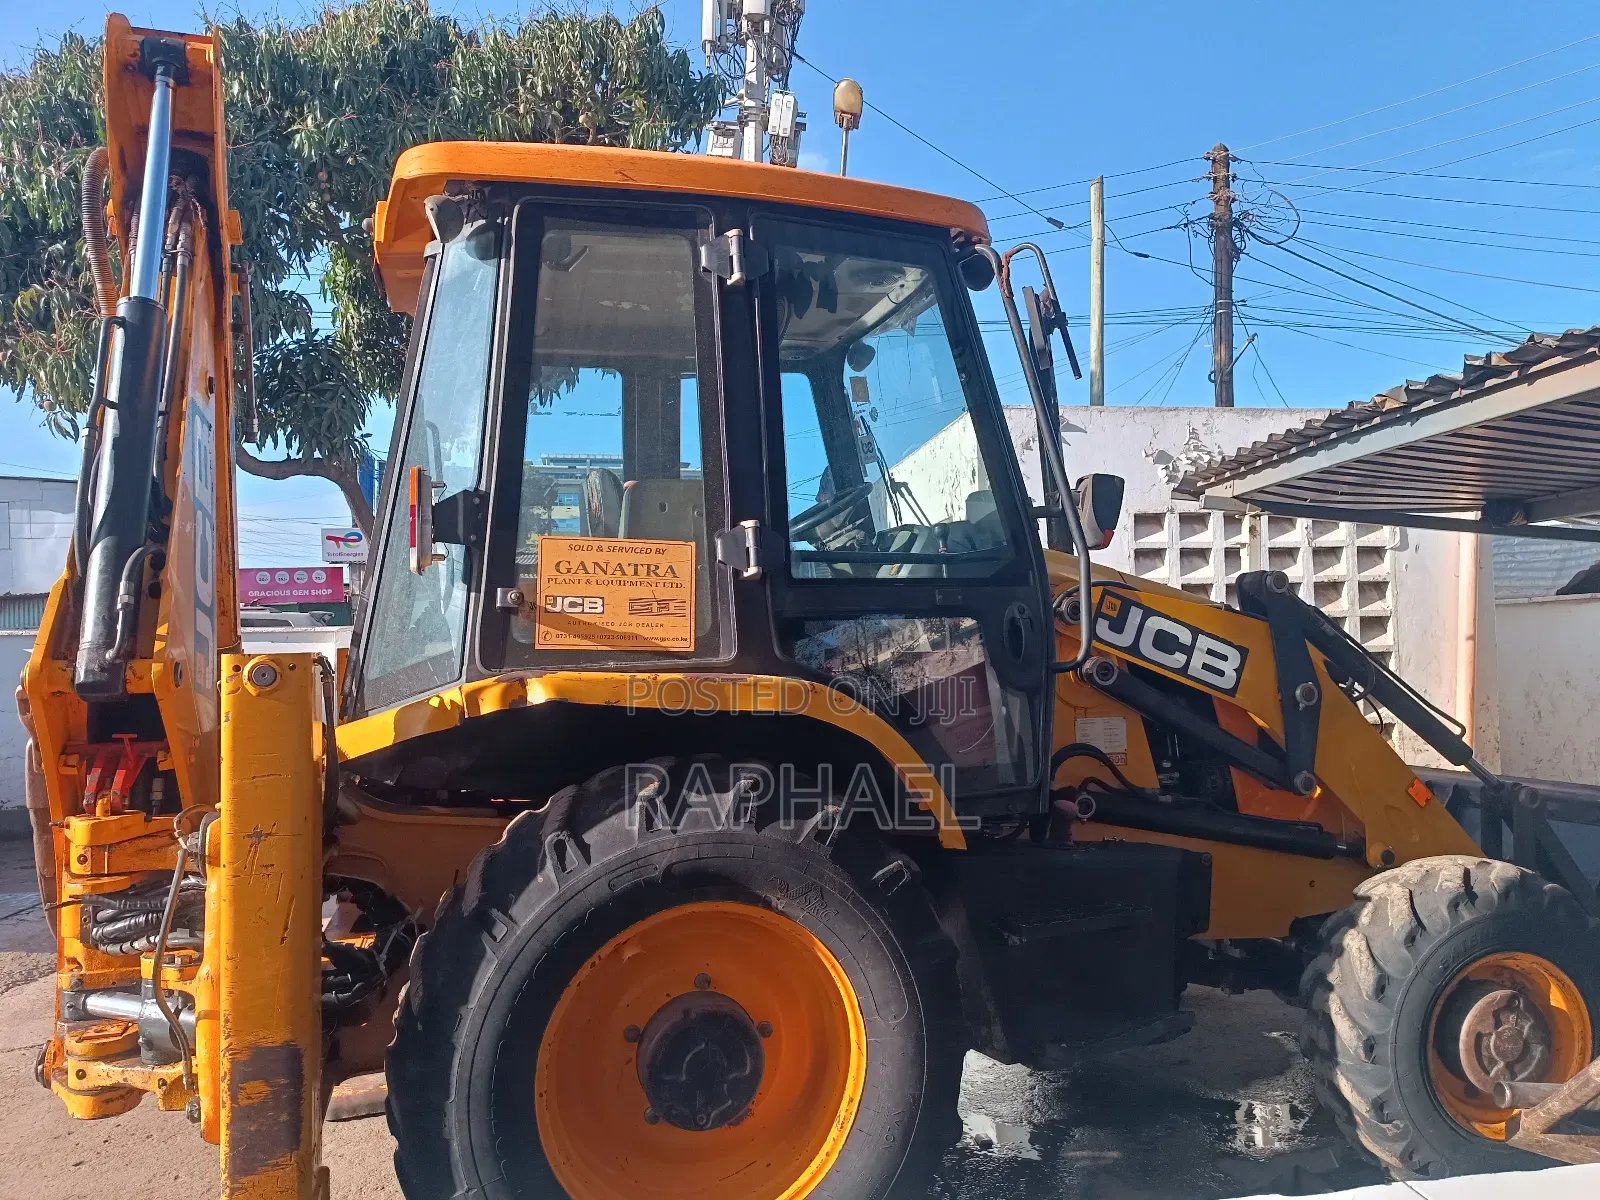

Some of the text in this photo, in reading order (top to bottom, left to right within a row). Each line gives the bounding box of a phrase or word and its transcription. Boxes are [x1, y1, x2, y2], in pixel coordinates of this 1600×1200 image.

[567, 543, 593, 552] SOLD
[595, 545, 604, 553] &
[606, 545, 652, 554] SERVICED
[554, 559, 680, 579] GANATRA
[547, 577, 582, 585] PLANT
[595, 579, 661, 588] EQUIPMENT
[662, 581, 686, 589] LTD.
[248, 589, 291, 597] GRACIOUS
[545, 597, 604, 614] JCB
[1095, 605, 1242, 690] JCB
